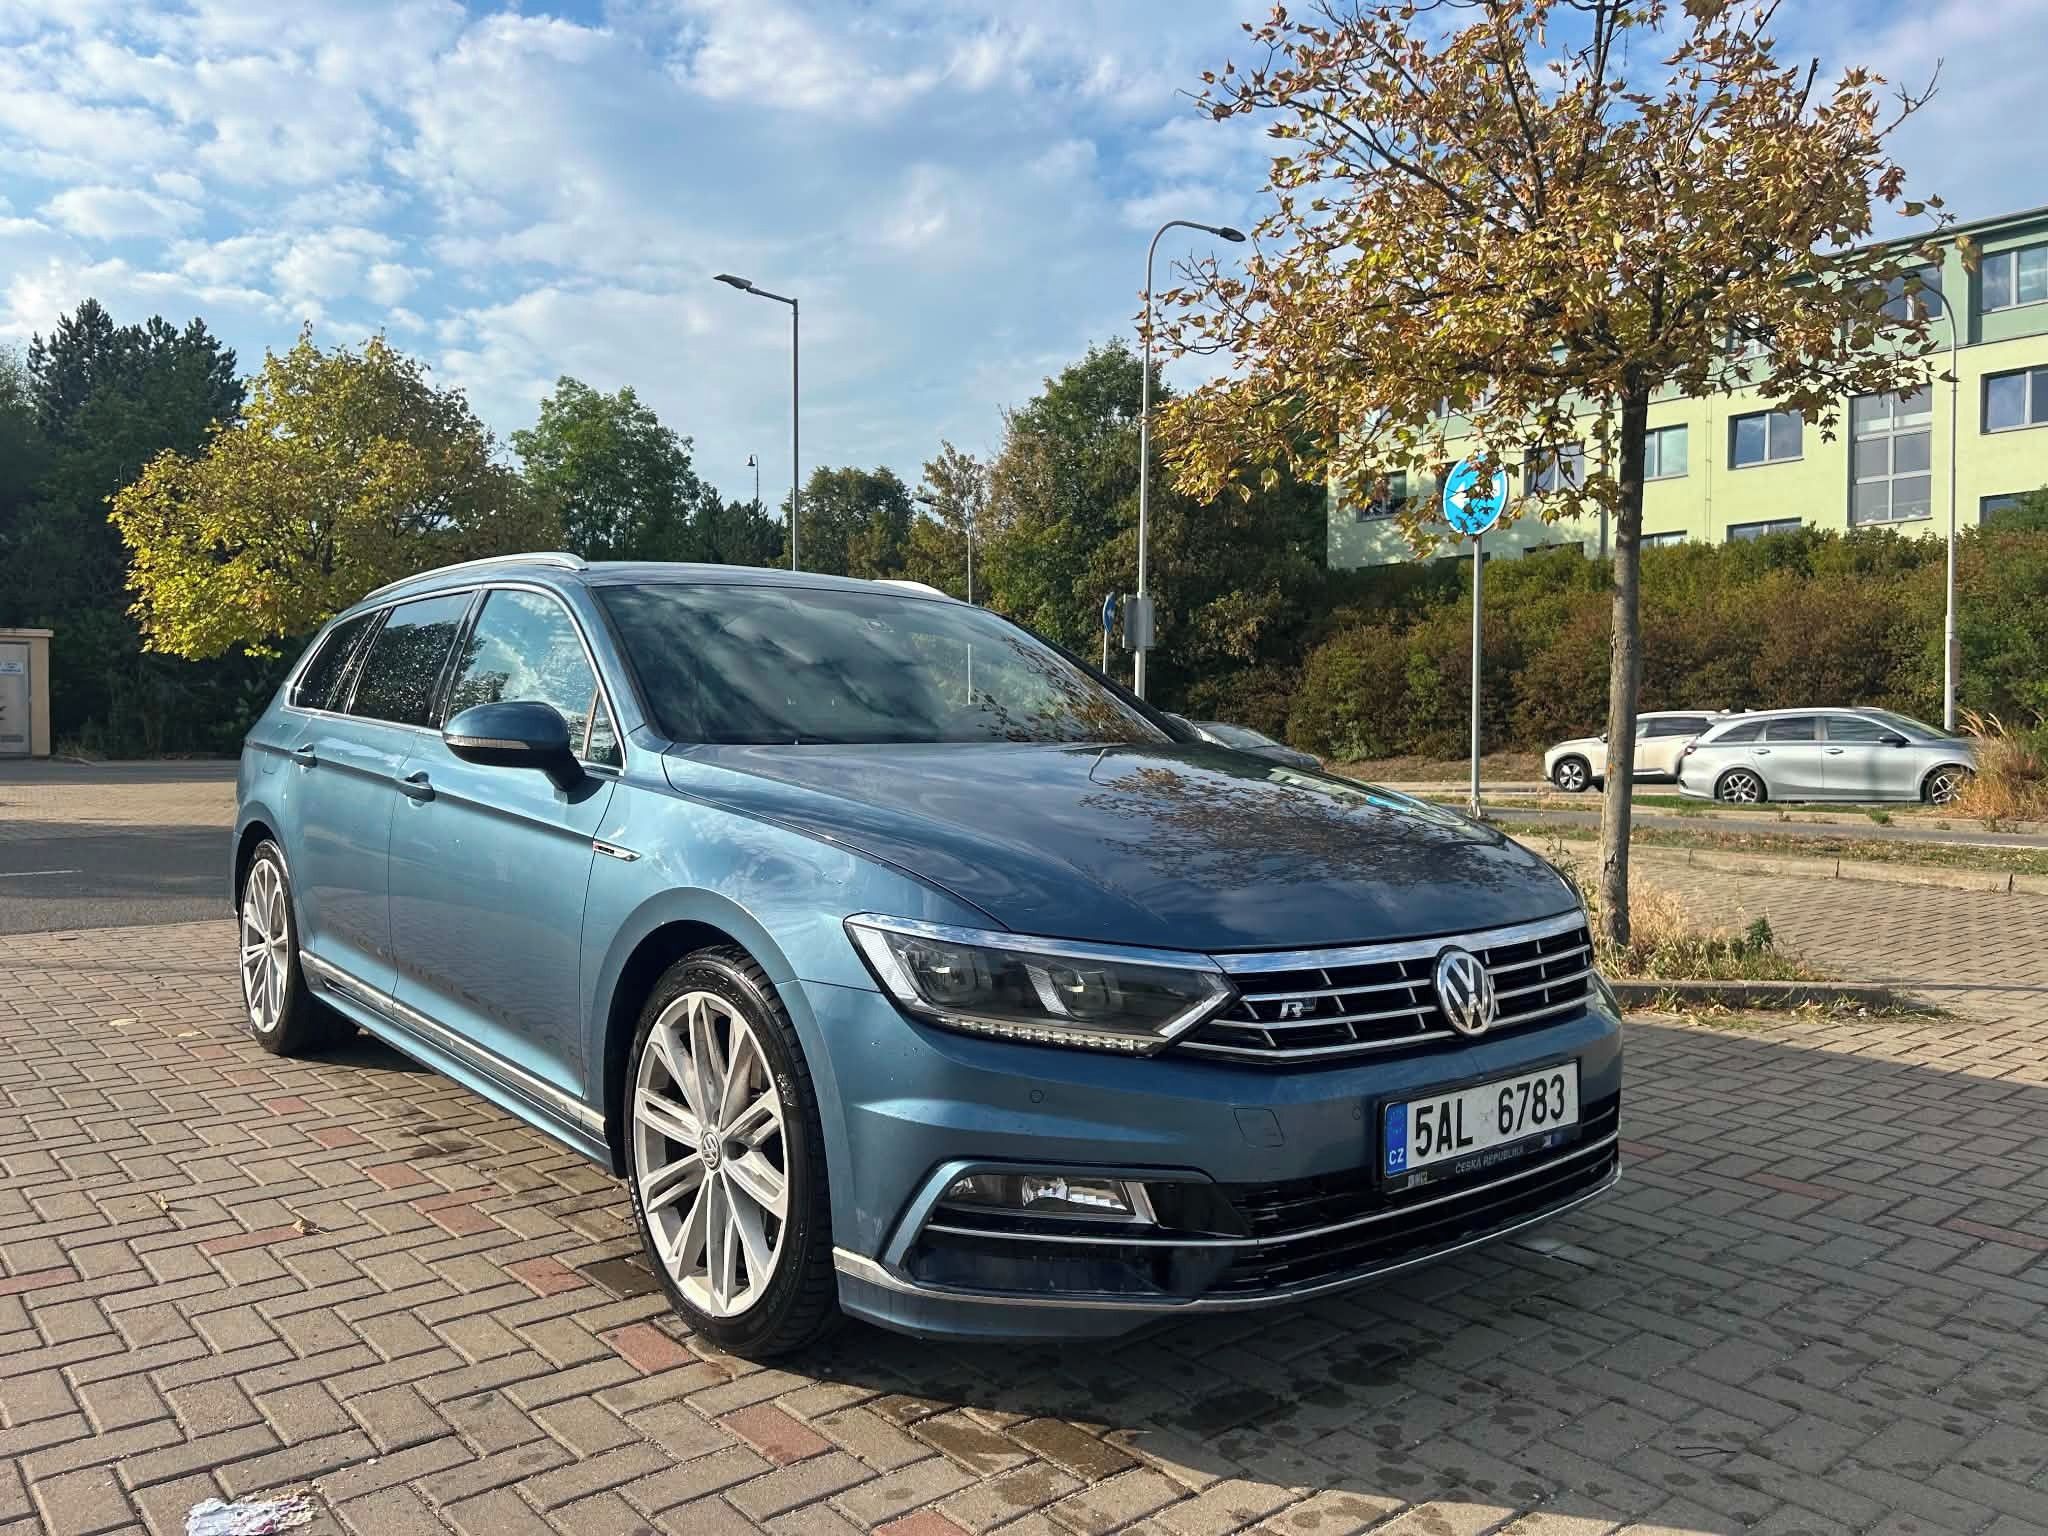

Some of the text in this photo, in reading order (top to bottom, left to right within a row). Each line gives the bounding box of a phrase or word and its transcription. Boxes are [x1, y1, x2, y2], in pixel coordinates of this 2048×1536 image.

[1415, 1074, 1565, 1157] 5AL 6783
[1388, 1147, 1405, 1166] CZ
